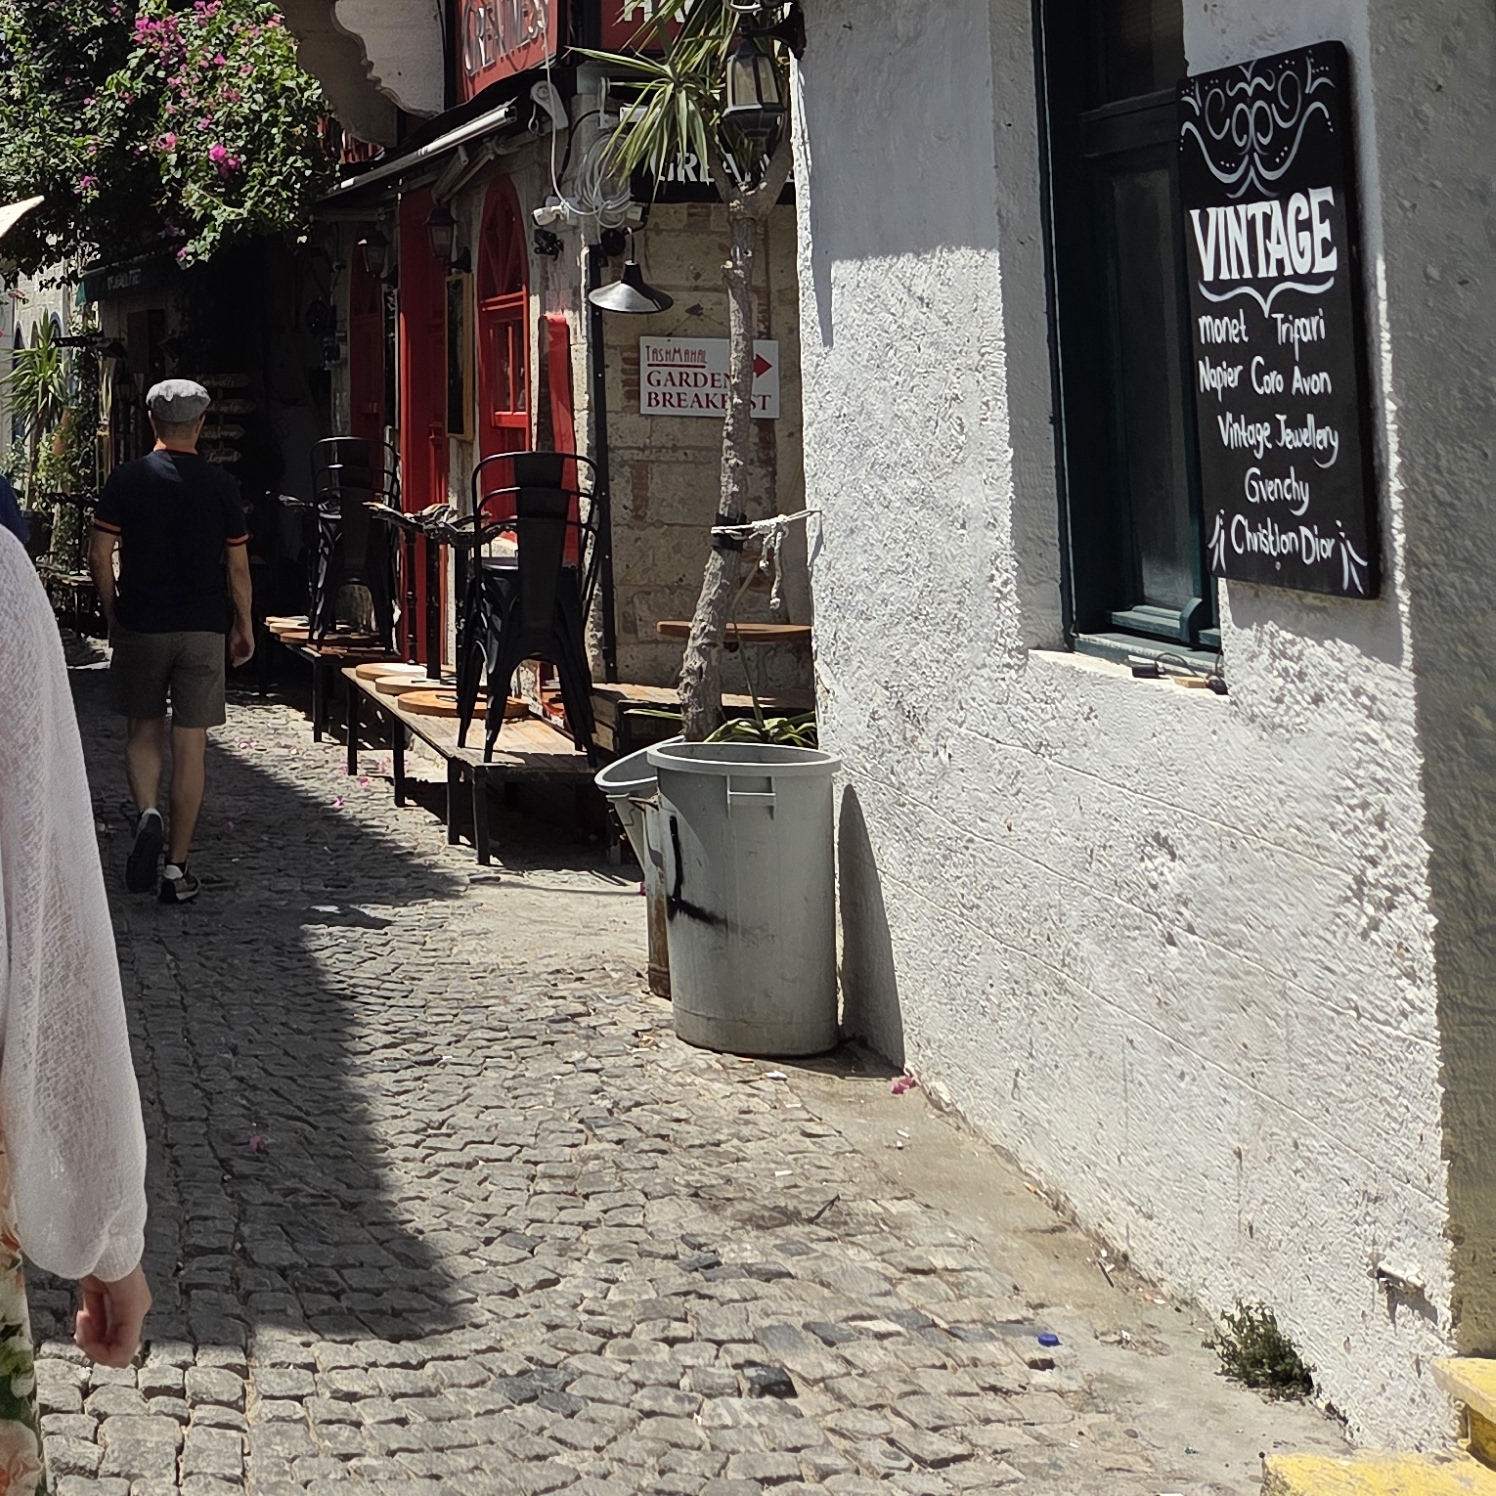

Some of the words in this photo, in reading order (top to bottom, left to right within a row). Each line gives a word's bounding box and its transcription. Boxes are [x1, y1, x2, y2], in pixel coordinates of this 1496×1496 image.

[1189, 186, 1338, 281] VINTAGE
[647, 391, 772, 411] BREAKFST
[1198, 355, 1243, 403] Napier
[1251, 355, 1284, 395] Coro
[1291, 365, 1332, 396] Avon
[1217, 411, 1272, 460] Vintage
[1275, 413, 1339, 469] Jewellery
[1299, 524, 1335, 565] Dior
